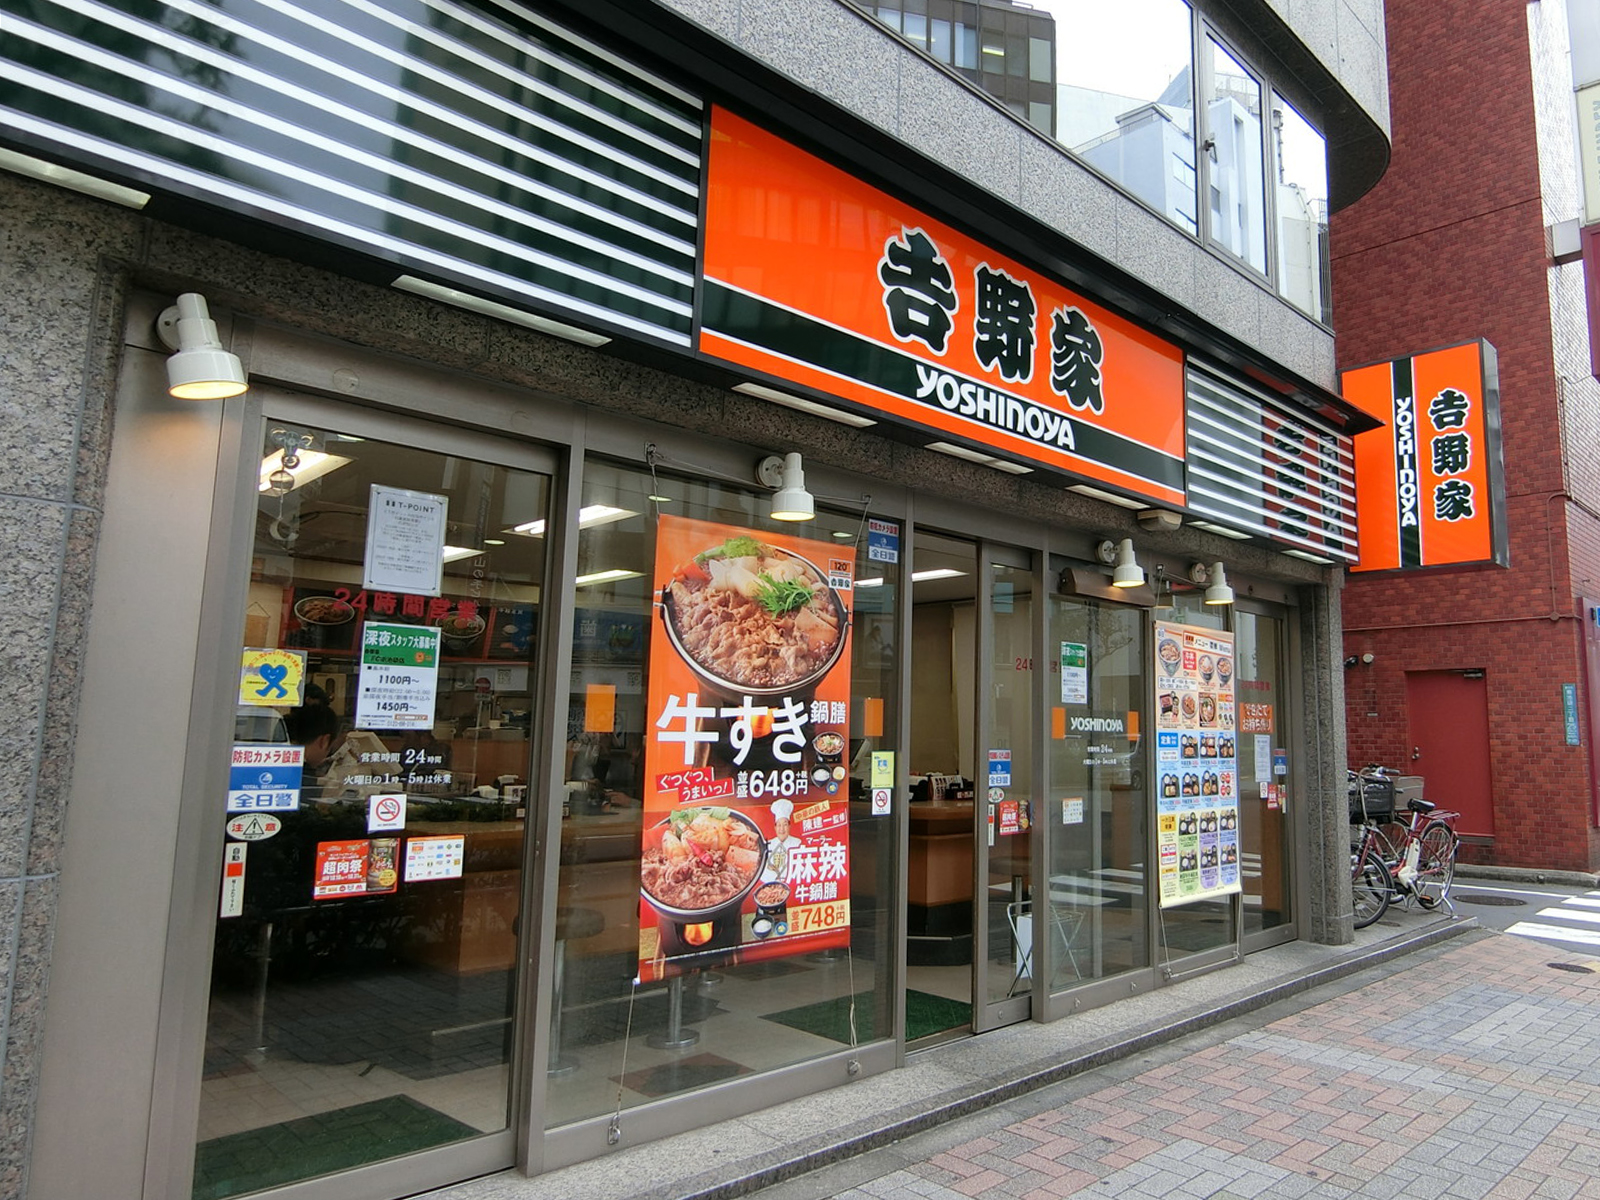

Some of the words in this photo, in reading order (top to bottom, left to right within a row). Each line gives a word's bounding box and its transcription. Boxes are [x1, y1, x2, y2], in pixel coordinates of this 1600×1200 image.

[877, 224, 1104, 415] 吉野家
[915, 364, 1076, 451] YOSHINOYA
[1395, 396, 1417, 527] YOSHINOYA
[1428, 388, 1475, 522] 吉野家
[398, 502, 435, 513] T-POINT
[1070, 716, 1124, 732] YOSHINOYA
[232, 750, 301, 764] 防犯カメラ設置
[360, 752, 400, 763] 営業時間
[235, 793, 292, 808] 全日警
[786, 841, 848, 885] 麻辣
[795, 881, 838, 904] 牛鍋膳
